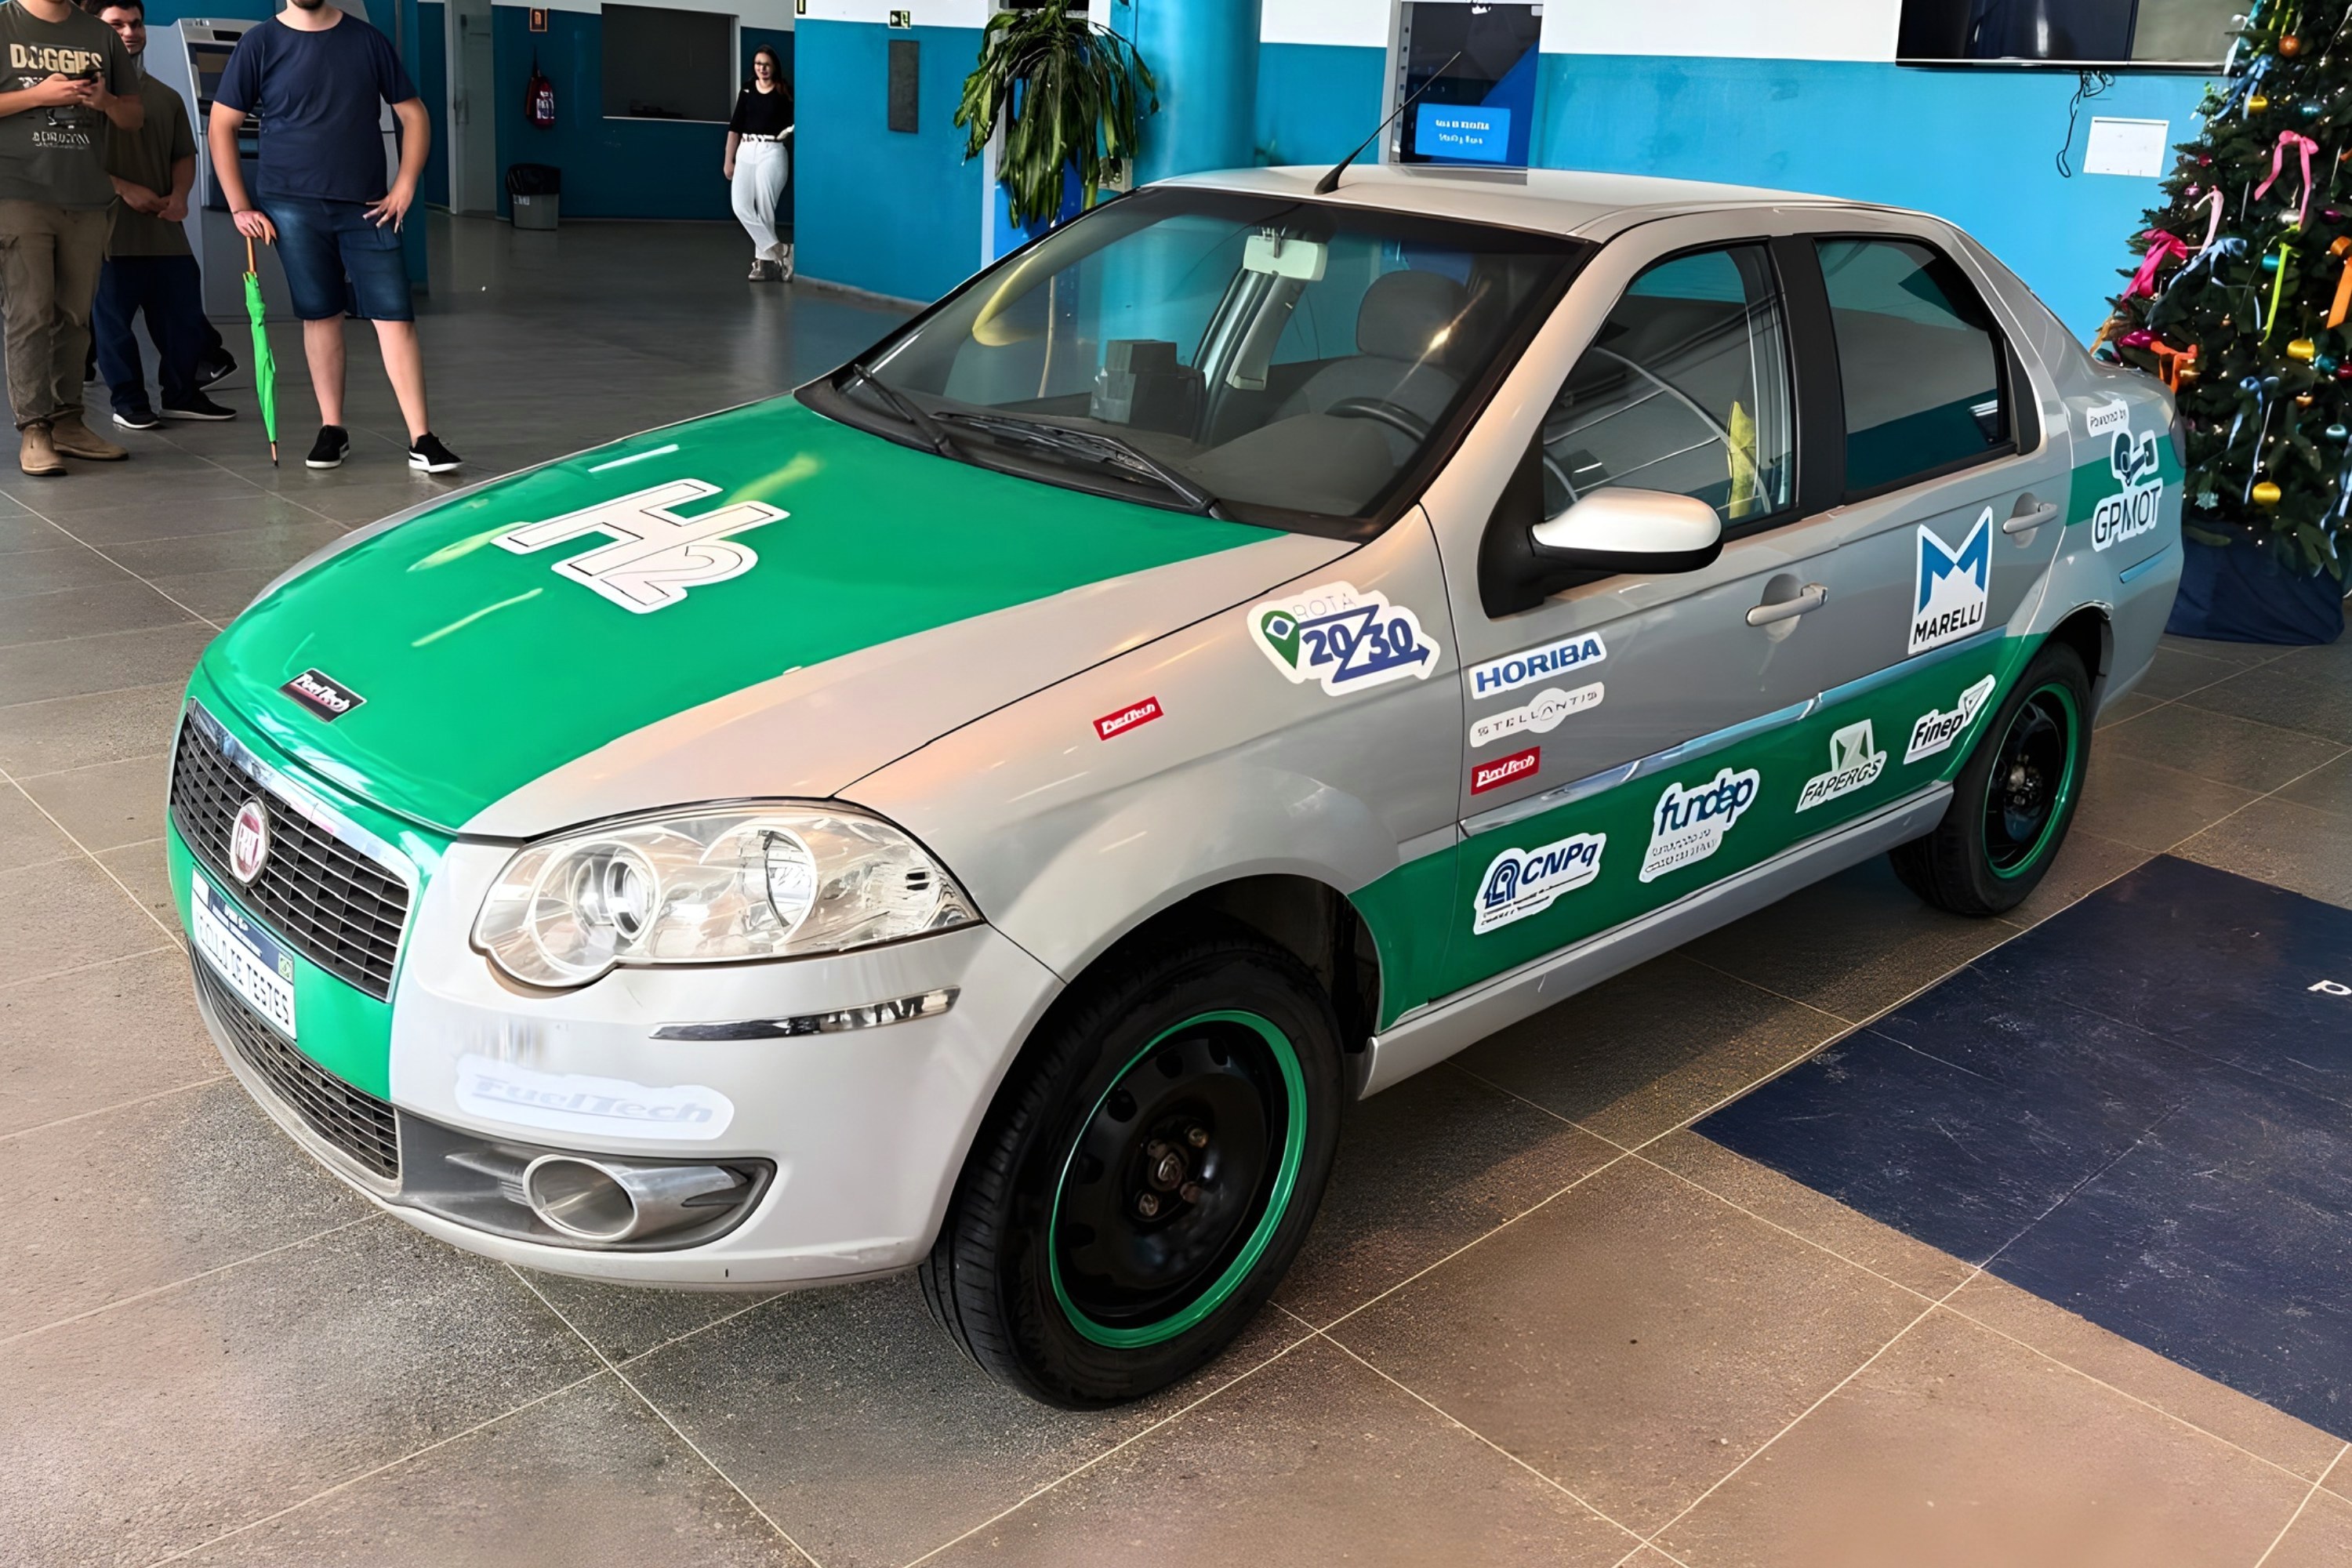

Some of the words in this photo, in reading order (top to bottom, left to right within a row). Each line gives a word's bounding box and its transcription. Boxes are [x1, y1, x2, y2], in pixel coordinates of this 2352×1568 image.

[2094, 485, 2161, 544] GPMOT
[1293, 593, 1357, 620] ROTA
[1913, 601, 1984, 645] MARELLI
[1475, 638, 1602, 693] HORIBA
[1477, 691, 1598, 737] STELLANTIS
[1911, 714, 1964, 750] Finep
[1800, 758, 1882, 806] FAPERGS
[1658, 778, 1754, 837] fundep
[1521, 842, 1599, 885] CNPq
[246, 963, 290, 1025] TESTES
[472, 1073, 714, 1123] FuelTech
